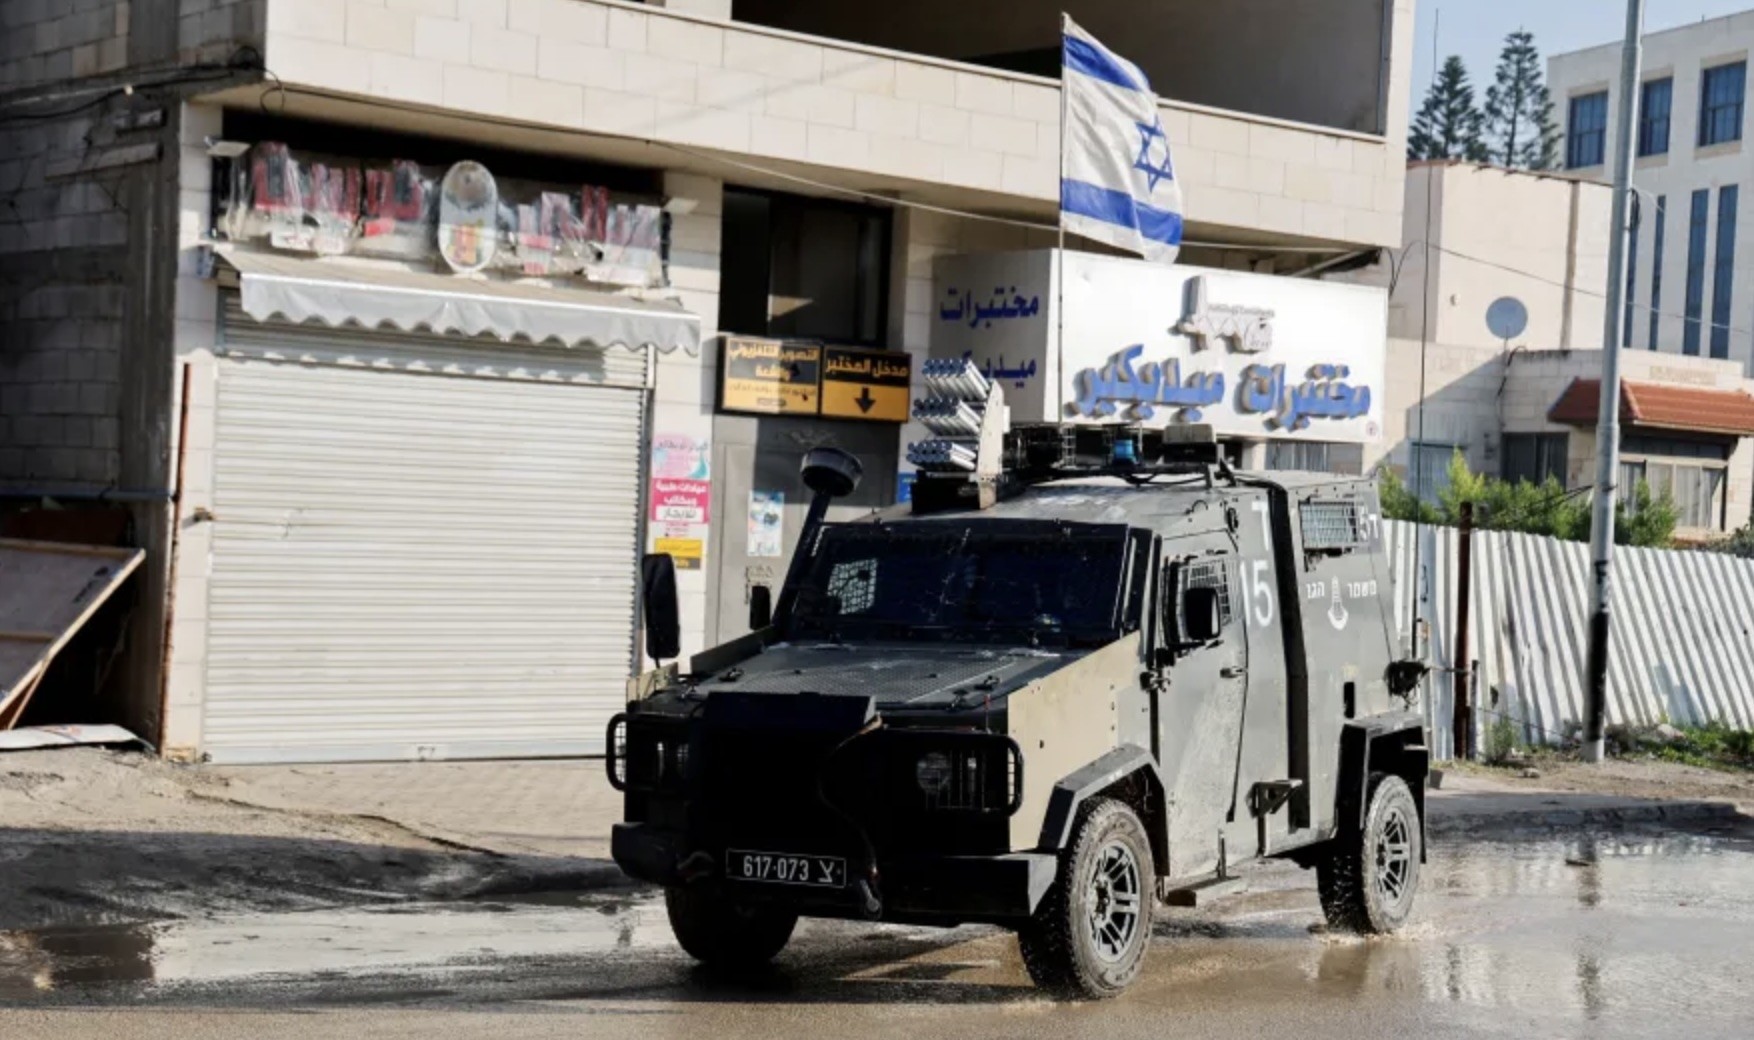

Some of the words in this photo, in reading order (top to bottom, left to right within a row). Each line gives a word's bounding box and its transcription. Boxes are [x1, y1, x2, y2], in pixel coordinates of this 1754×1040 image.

[939, 285, 1039, 329] مختبرات
[825, 354, 871, 376] المختبر
[872, 359, 908, 379] مدخل
[1068, 343, 1226, 422] ميديكير
[1237, 362, 1372, 432] مختبرات
[1240, 559, 1273, 627] 15
[1346, 579, 1376, 599] משמר
